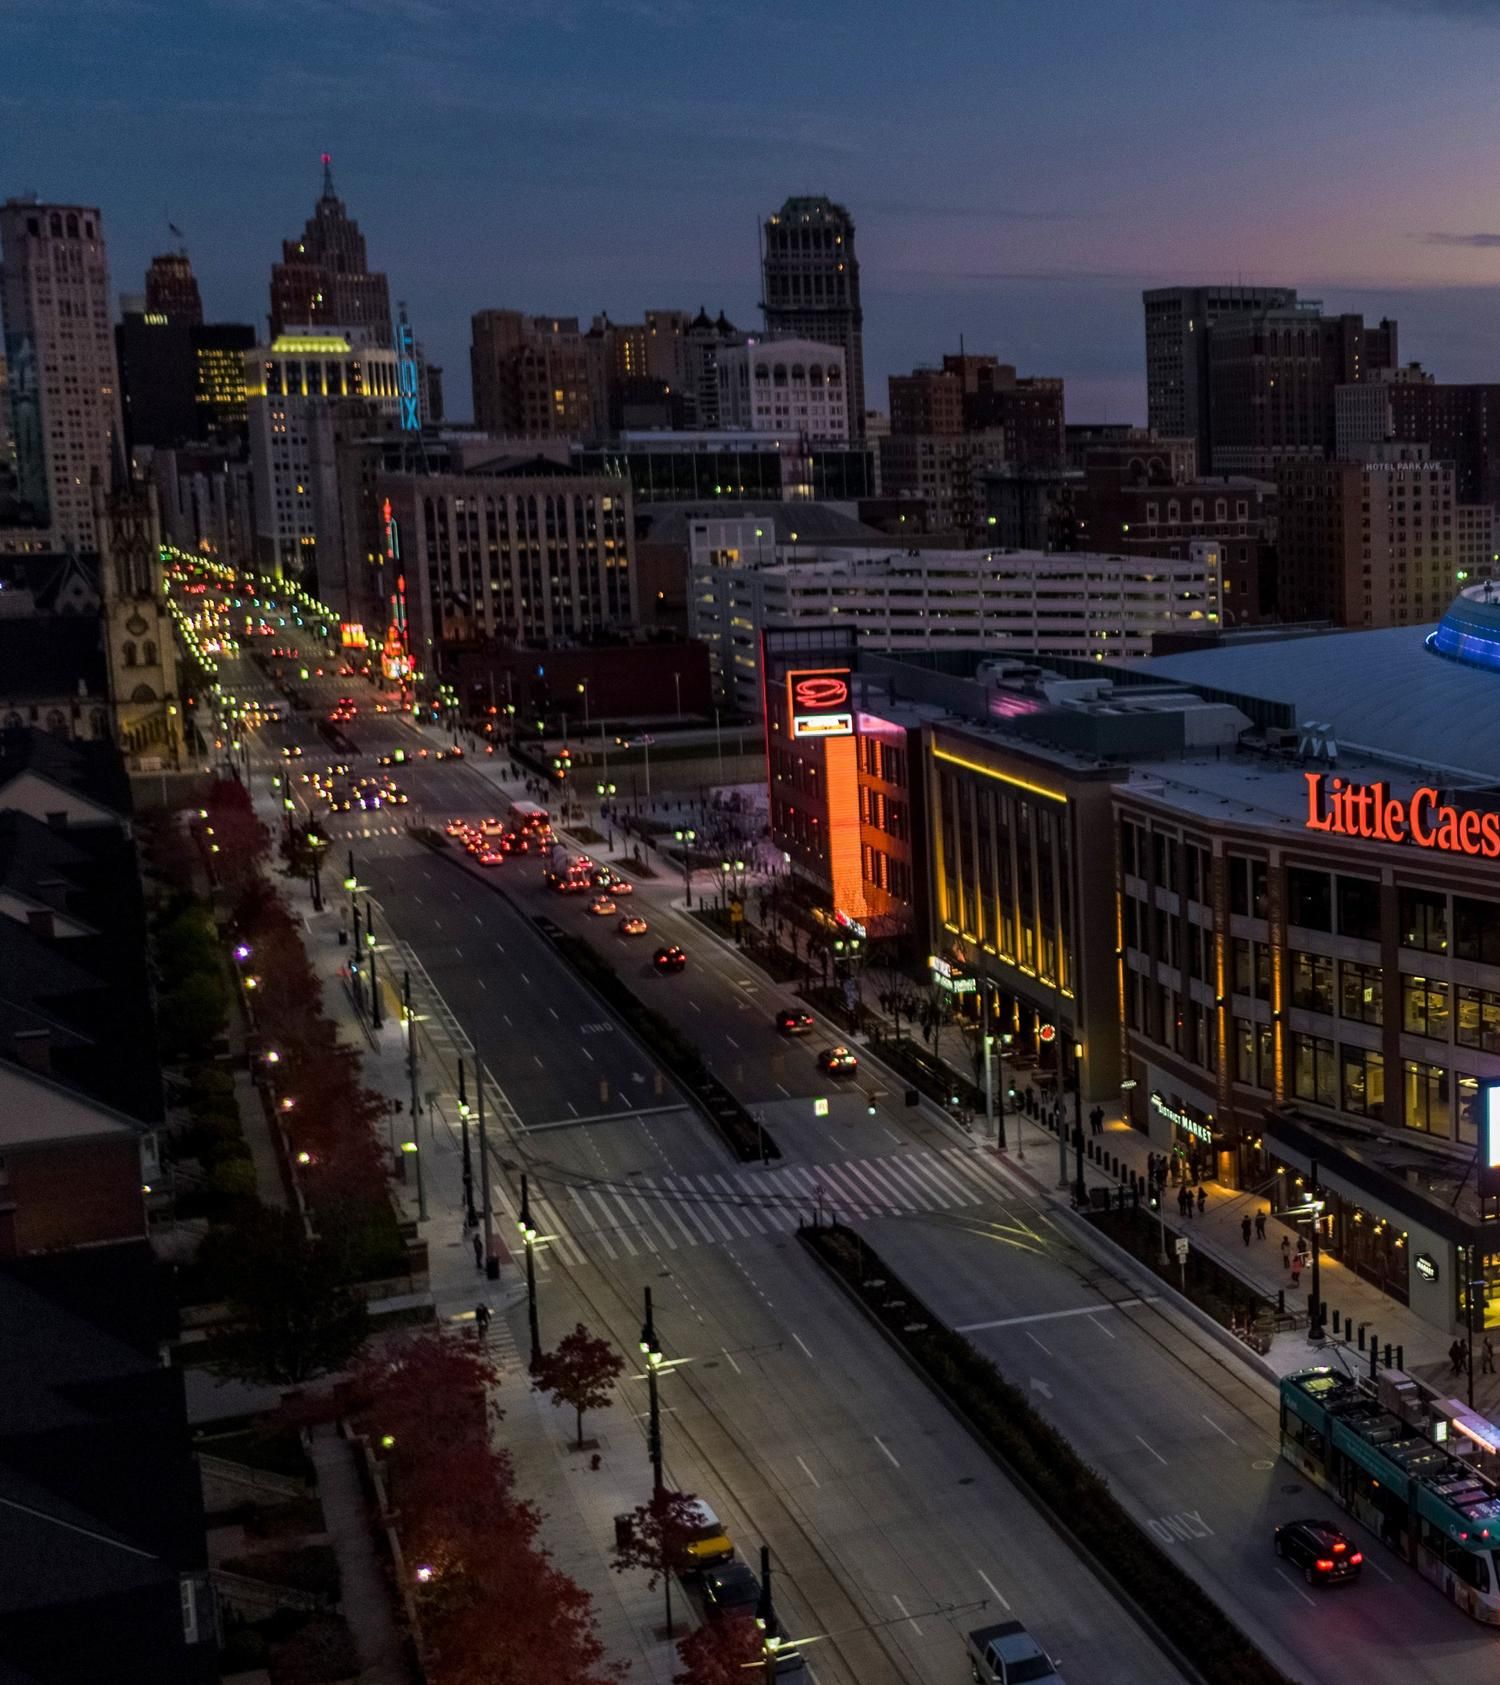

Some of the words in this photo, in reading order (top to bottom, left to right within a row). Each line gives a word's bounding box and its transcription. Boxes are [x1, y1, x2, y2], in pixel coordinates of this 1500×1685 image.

[400, 322, 421, 432] FOX
[1365, 463, 1396, 471] HOTEL
[1397, 462, 1421, 471] PARK
[1304, 772, 1405, 842] Little
[1182, 1116, 1212, 1144] MARKET
[1146, 1510, 1216, 1545] ONLY
